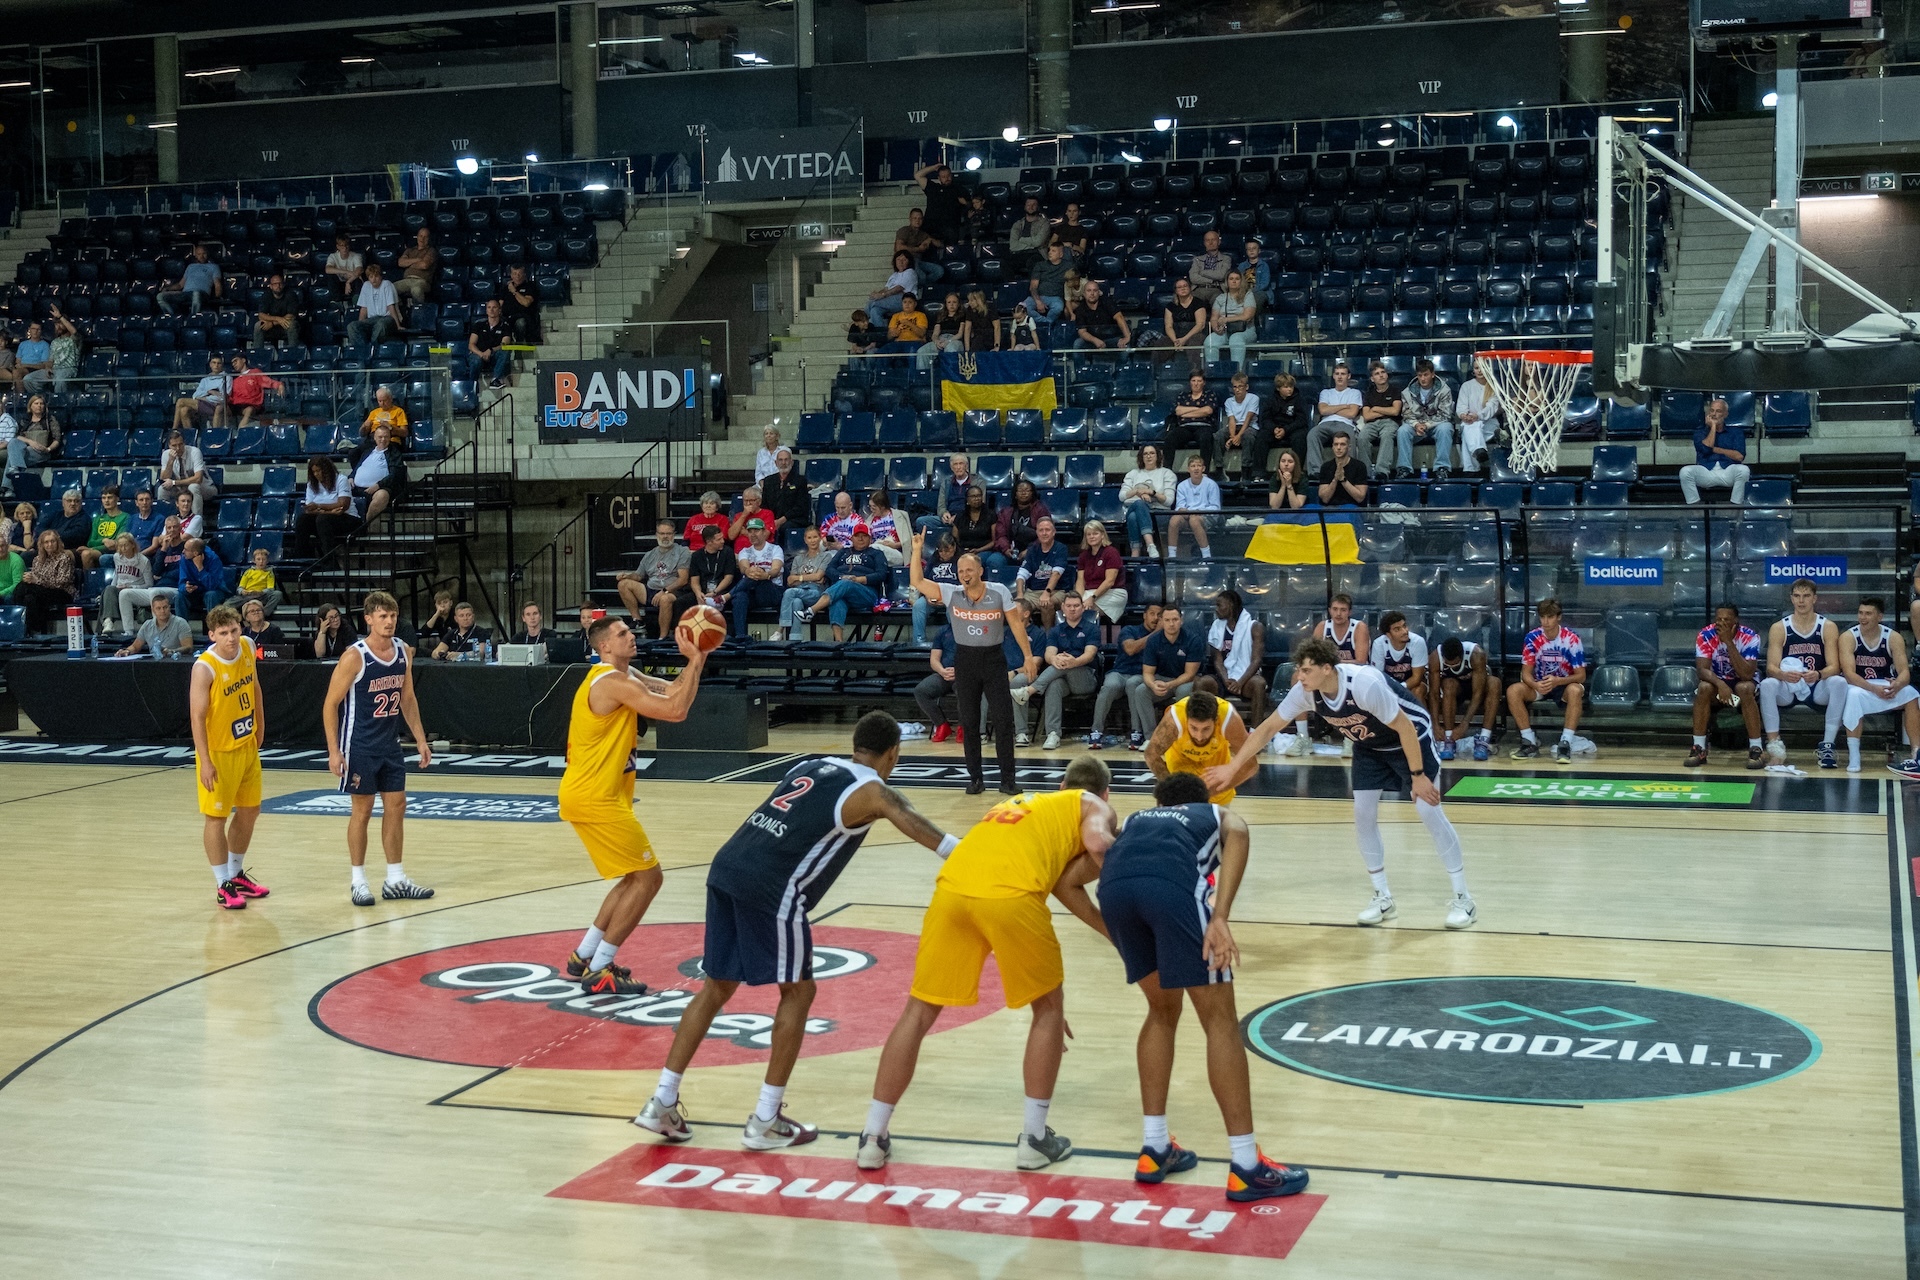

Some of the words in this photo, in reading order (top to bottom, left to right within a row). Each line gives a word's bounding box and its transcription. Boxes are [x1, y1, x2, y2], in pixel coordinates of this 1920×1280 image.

[1418, 80, 1442, 94] VIP
[1176, 95, 1198, 109] VIP
[907, 110, 928, 123] VIP
[686, 124, 706, 137] VIP
[451, 139, 470, 151] VIP
[262, 150, 279, 162] VIP
[741, 151, 855, 181] VYTEDA
[1816, 181, 1841, 191] WC
[762, 228, 783, 239] WC
[554, 368, 696, 412] BANDI
[609, 495, 640, 530] GF
[1589, 565, 1658, 579] balticum
[1770, 563, 1842, 577] balticum
[952, 605, 1001, 621] betsson
[238, 692, 251, 711] 19
[373, 691, 401, 718] 22
[1338, 724, 1376, 741] 12
[1494, 781, 1615, 791] mini
[769, 776, 815, 812] 2
[1488, 788, 1711, 800] MARKET
[746, 811, 788, 838] HOLMES
[1281, 1021, 1783, 1070] LAIKRODZIAI.LT
